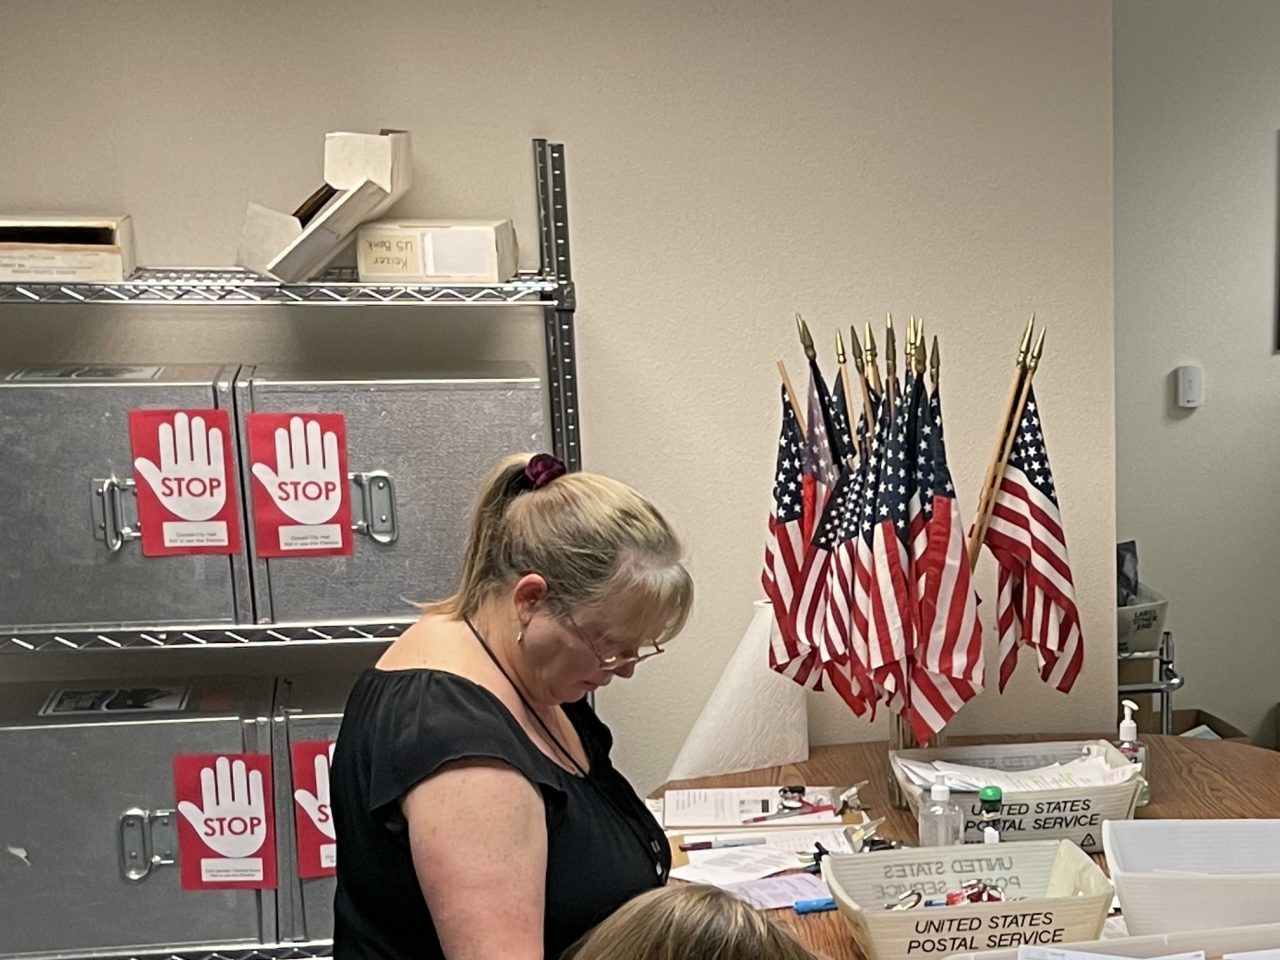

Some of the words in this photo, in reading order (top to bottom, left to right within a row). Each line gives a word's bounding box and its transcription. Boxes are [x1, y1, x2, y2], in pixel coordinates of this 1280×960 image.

[366, 239, 391, 252] Bank
[396, 241, 413, 252] US
[161, 477, 221, 498] STOP
[278, 481, 337, 501] STOP
[970, 803, 1030, 816] UTED
[1034, 799, 1092, 814] STATES
[203, 816, 262, 837] STOP
[964, 819, 1027, 833] POTAL
[1032, 813, 1100, 830] SERVICE
[915, 917, 982, 935] UNITED
[988, 911, 1054, 929] STATES
[906, 936, 979, 955] POSTAL
[986, 928, 1065, 949] SERVICE
